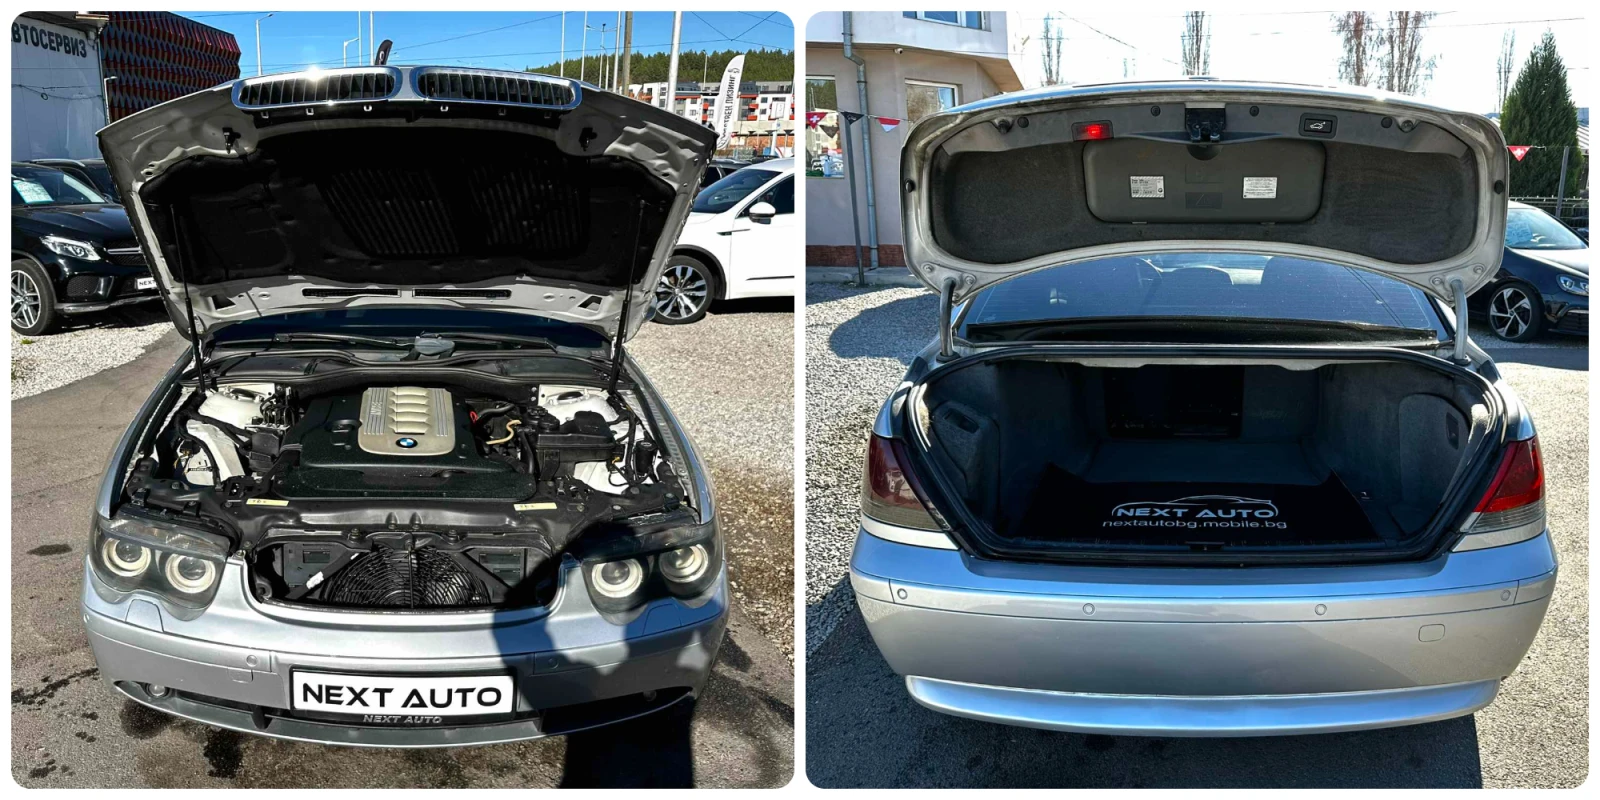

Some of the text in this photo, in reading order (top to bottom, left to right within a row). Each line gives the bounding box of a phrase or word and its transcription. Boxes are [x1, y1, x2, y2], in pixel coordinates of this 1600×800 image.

[11, 22, 87, 58] ВТОСЕРВИЗ
[725, 75, 736, 104] ЛИЗИНГ
[1116, 508, 1274, 518] NEXT AUTO
[1102, 519, 1287, 529] nextautobg.mobile.bg
[302, 682, 502, 708] NEXT AUTO
[363, 715, 442, 724] NEXT AUTO
